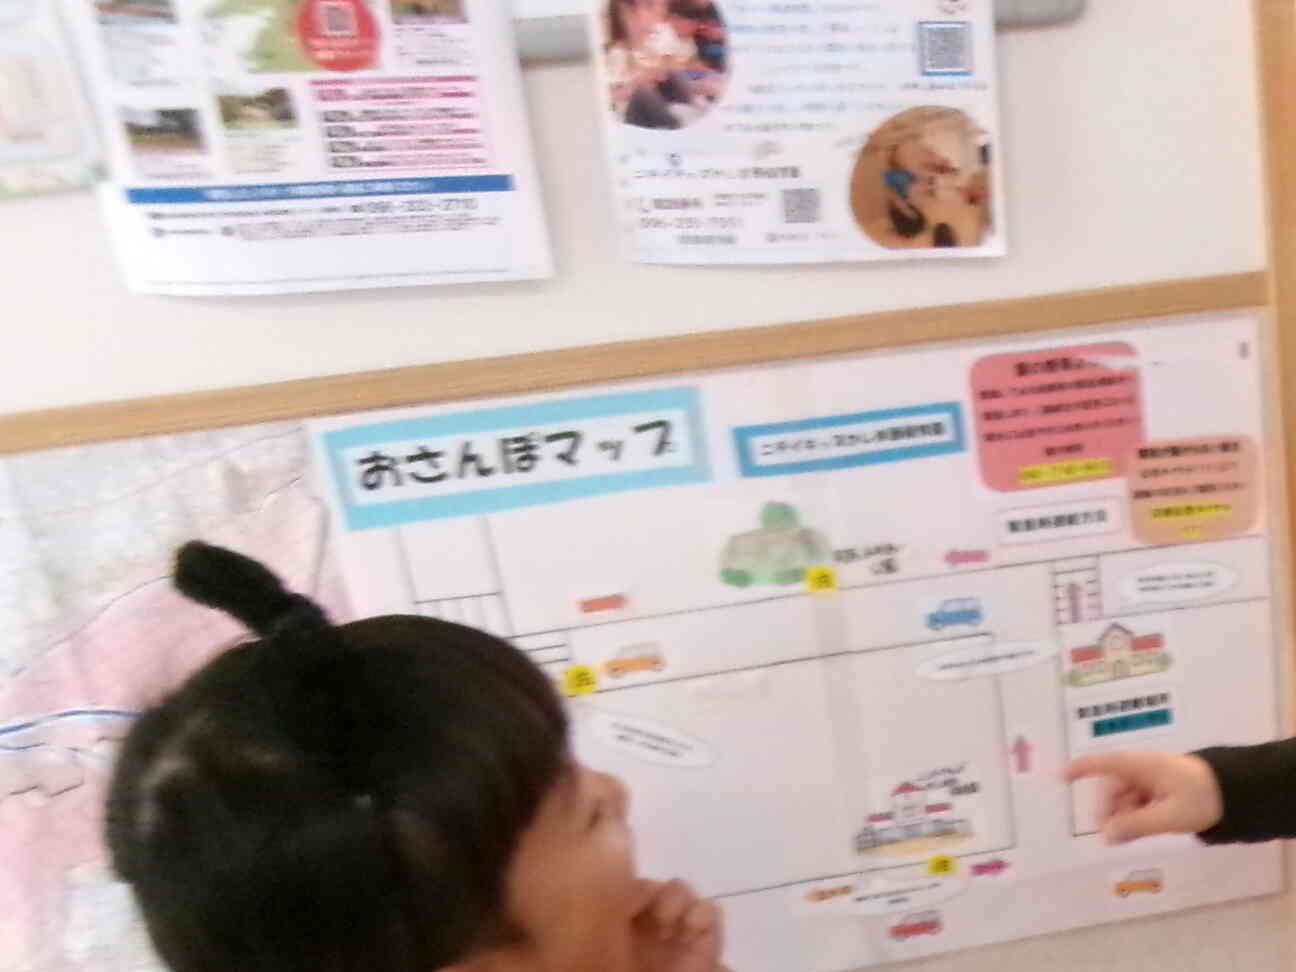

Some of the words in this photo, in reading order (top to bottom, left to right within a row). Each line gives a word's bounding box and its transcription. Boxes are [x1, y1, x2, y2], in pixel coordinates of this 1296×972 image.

[357, 419, 675, 491] おさんぽマップ
